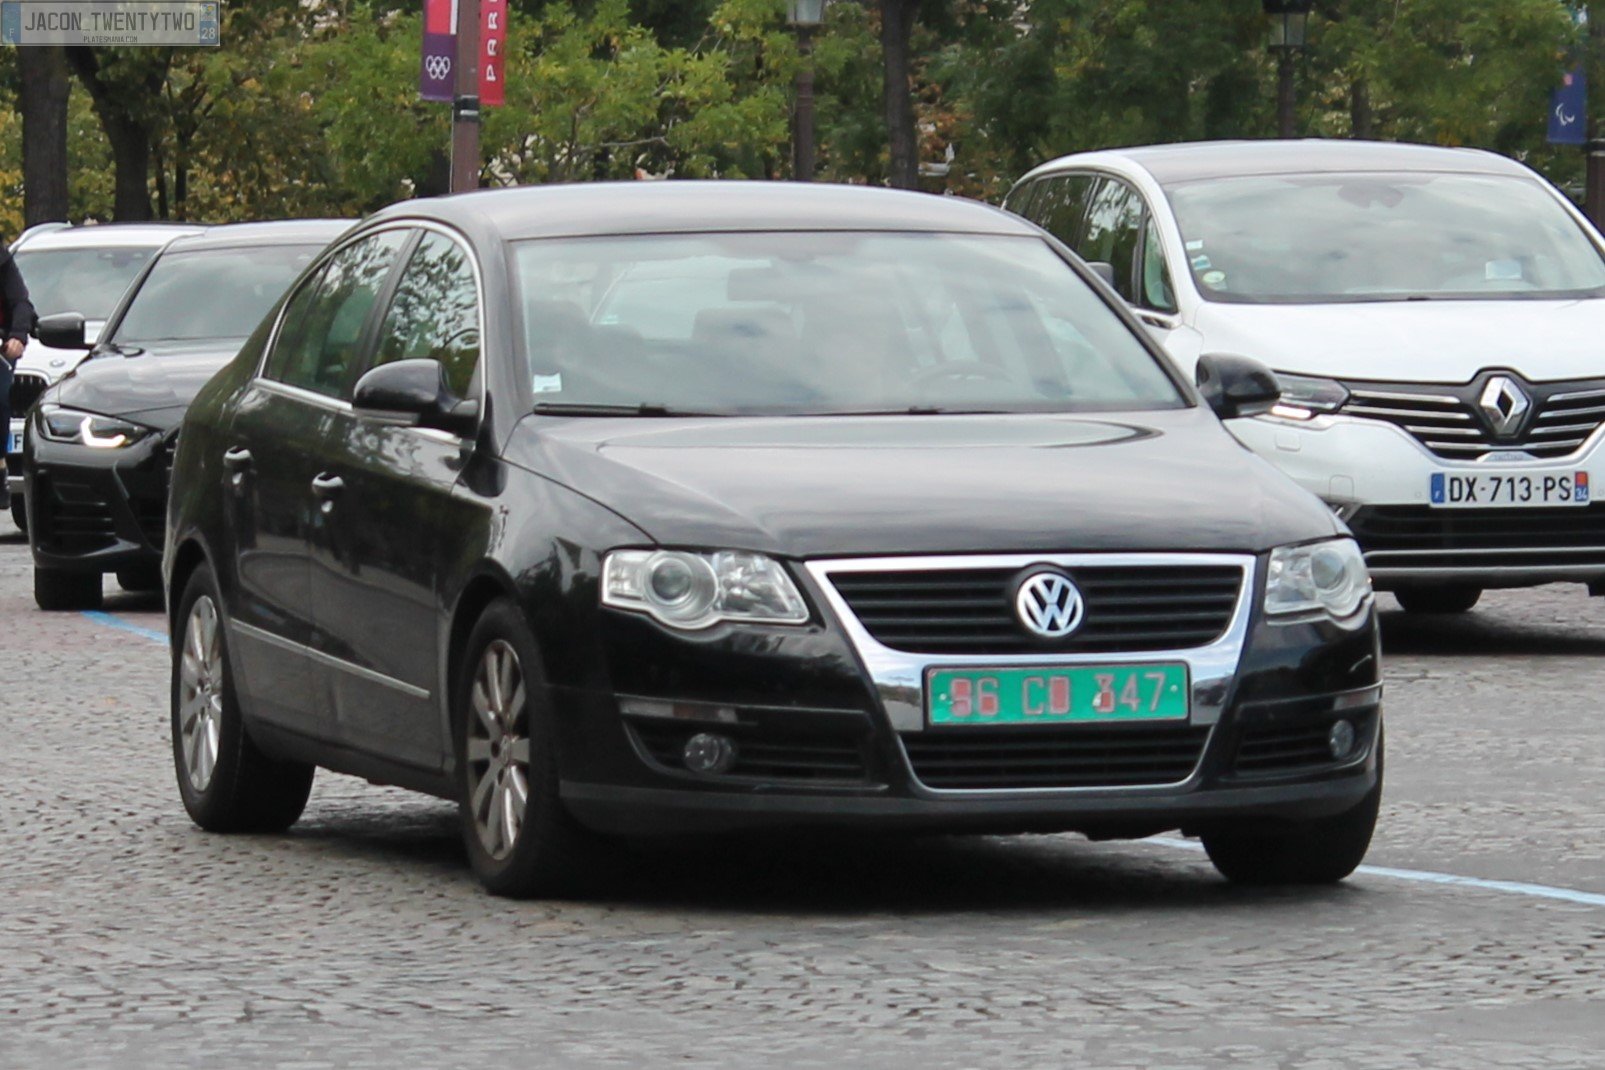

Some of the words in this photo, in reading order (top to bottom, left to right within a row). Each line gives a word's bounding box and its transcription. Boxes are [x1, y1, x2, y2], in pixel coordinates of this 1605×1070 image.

[1449, 476, 1572, 502] DX-713-PS
[1575, 488, 1588, 500] 34
[1022, 675, 1070, 716] CD
[1093, 672, 1166, 713] 347
